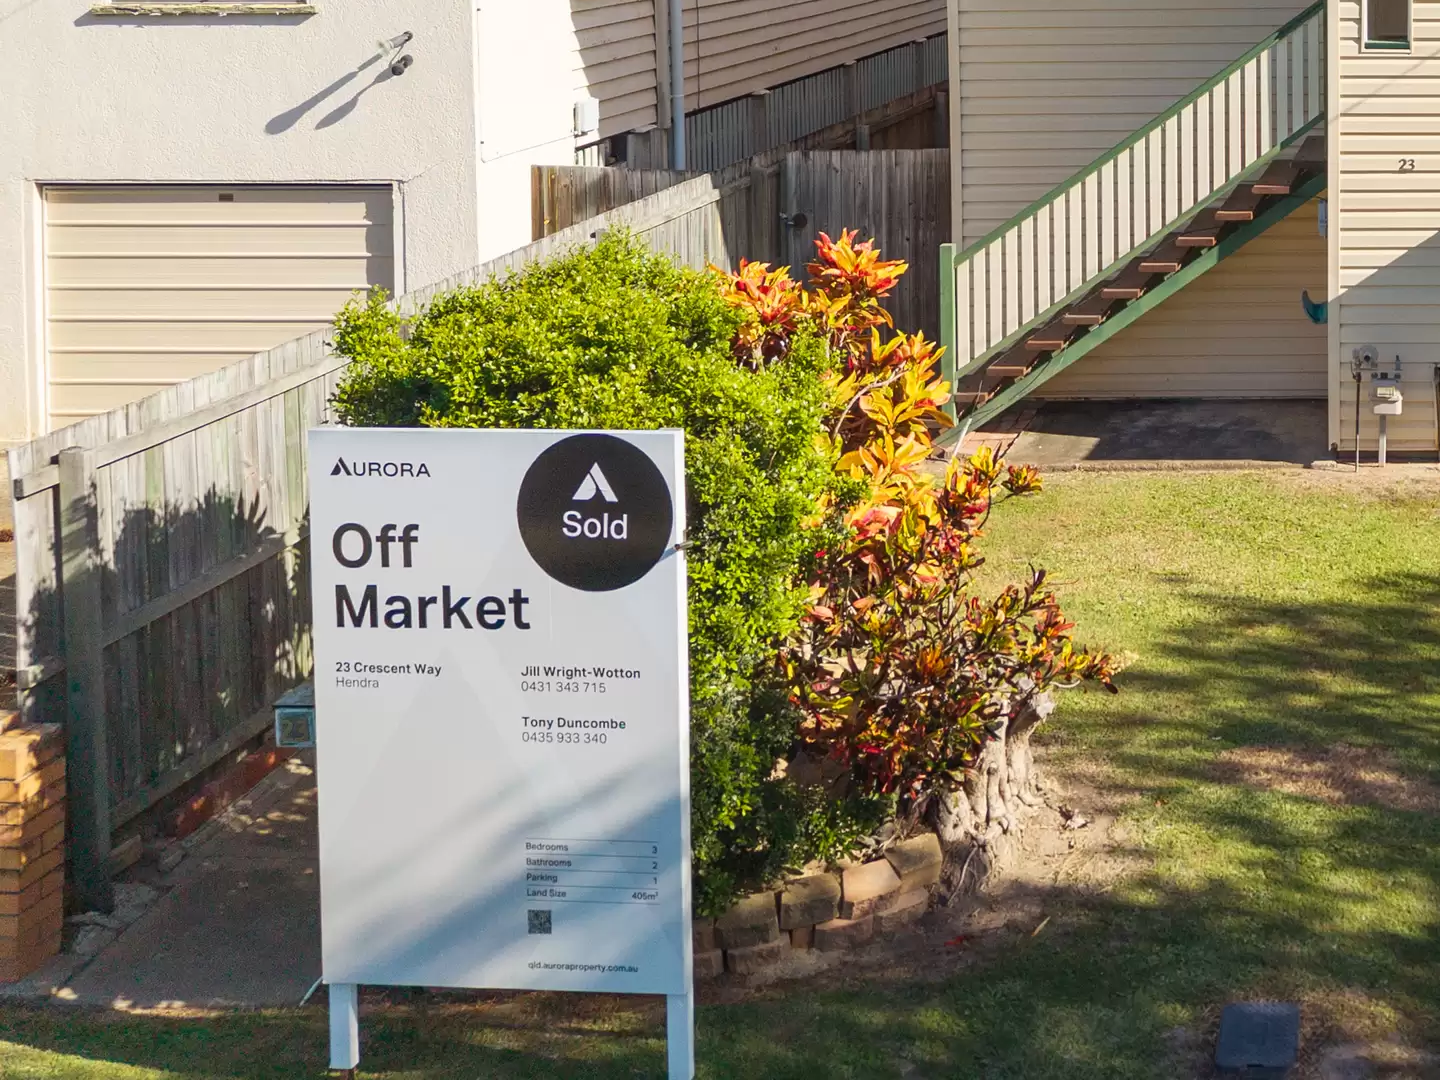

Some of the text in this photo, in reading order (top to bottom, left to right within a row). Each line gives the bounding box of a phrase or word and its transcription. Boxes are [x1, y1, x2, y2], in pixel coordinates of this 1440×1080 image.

[1398, 159, 1416, 173] 23
[330, 456, 431, 478] AURORA
[562, 511, 628, 540] Sold
[332, 523, 419, 568] Off
[335, 584, 531, 630] Market
[335, 662, 442, 677] 23 Crescent Way
[521, 666, 641, 680] Jill Wright-Wotton
[336, 677, 379, 688] Hendra
[521, 681, 606, 693] 0431 343 715
[521, 716, 626, 730] Tony Duncombe
[521, 731, 607, 744] 0435 933 340
[525, 842, 569, 851] Bedrooms
[526, 858, 572, 867] Bathrooms
[526, 873, 558, 883] Parking
[526, 889, 567, 898] Land Size
